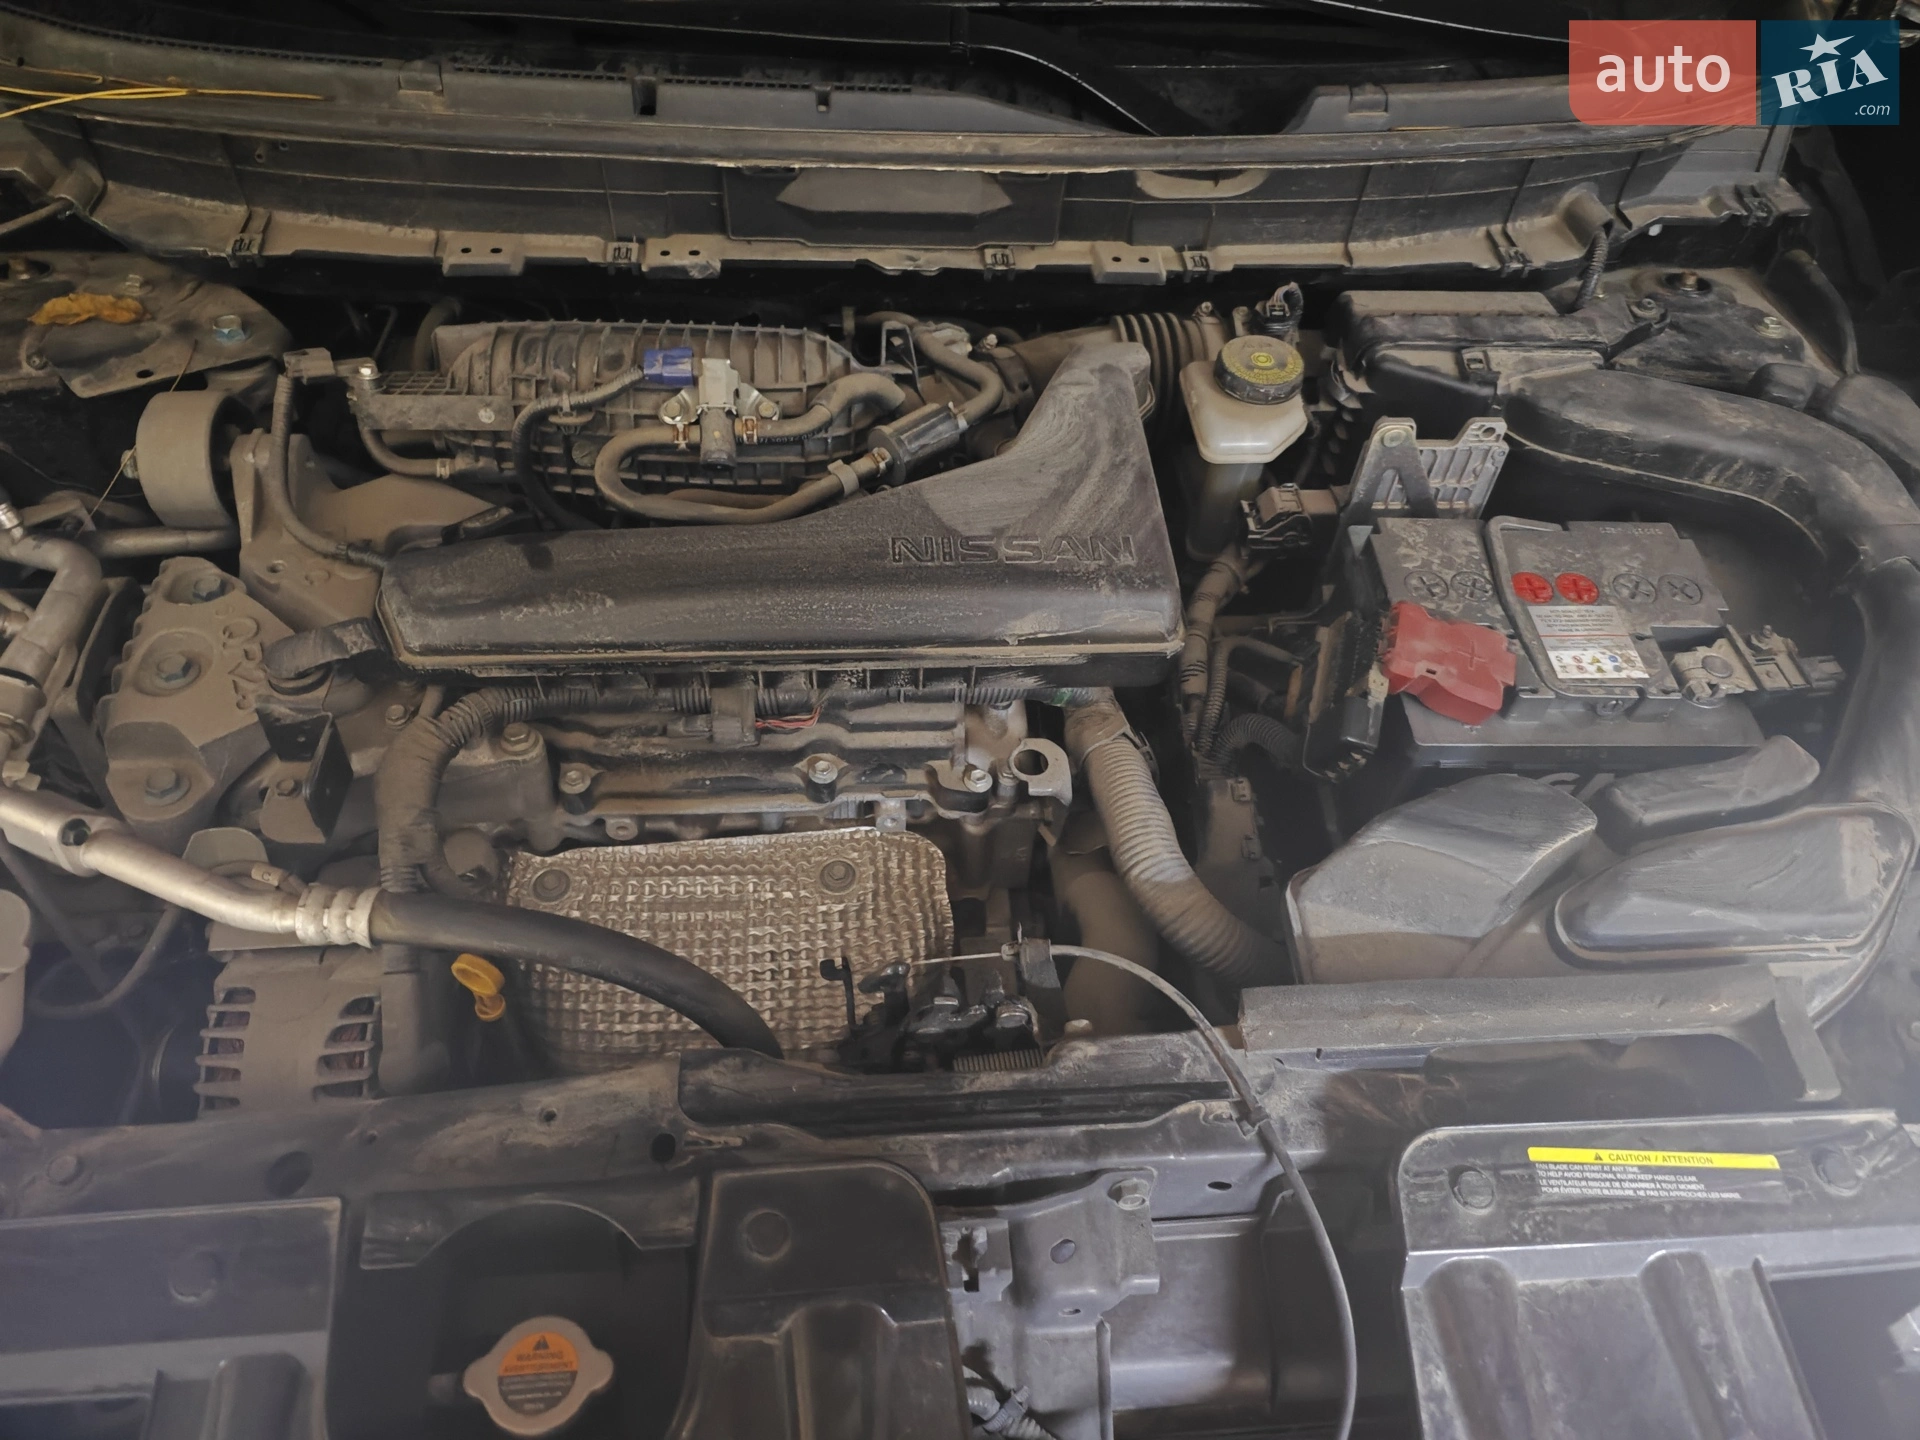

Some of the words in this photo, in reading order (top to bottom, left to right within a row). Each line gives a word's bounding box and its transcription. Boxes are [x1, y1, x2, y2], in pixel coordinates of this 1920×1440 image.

[890, 535, 1137, 564] NISSAN
[1608, 1153, 1651, 1162] CAUTION
[1662, 1155, 1714, 1164] ATTENTION
[1588, 1180, 1611, 1188] RISQUE
